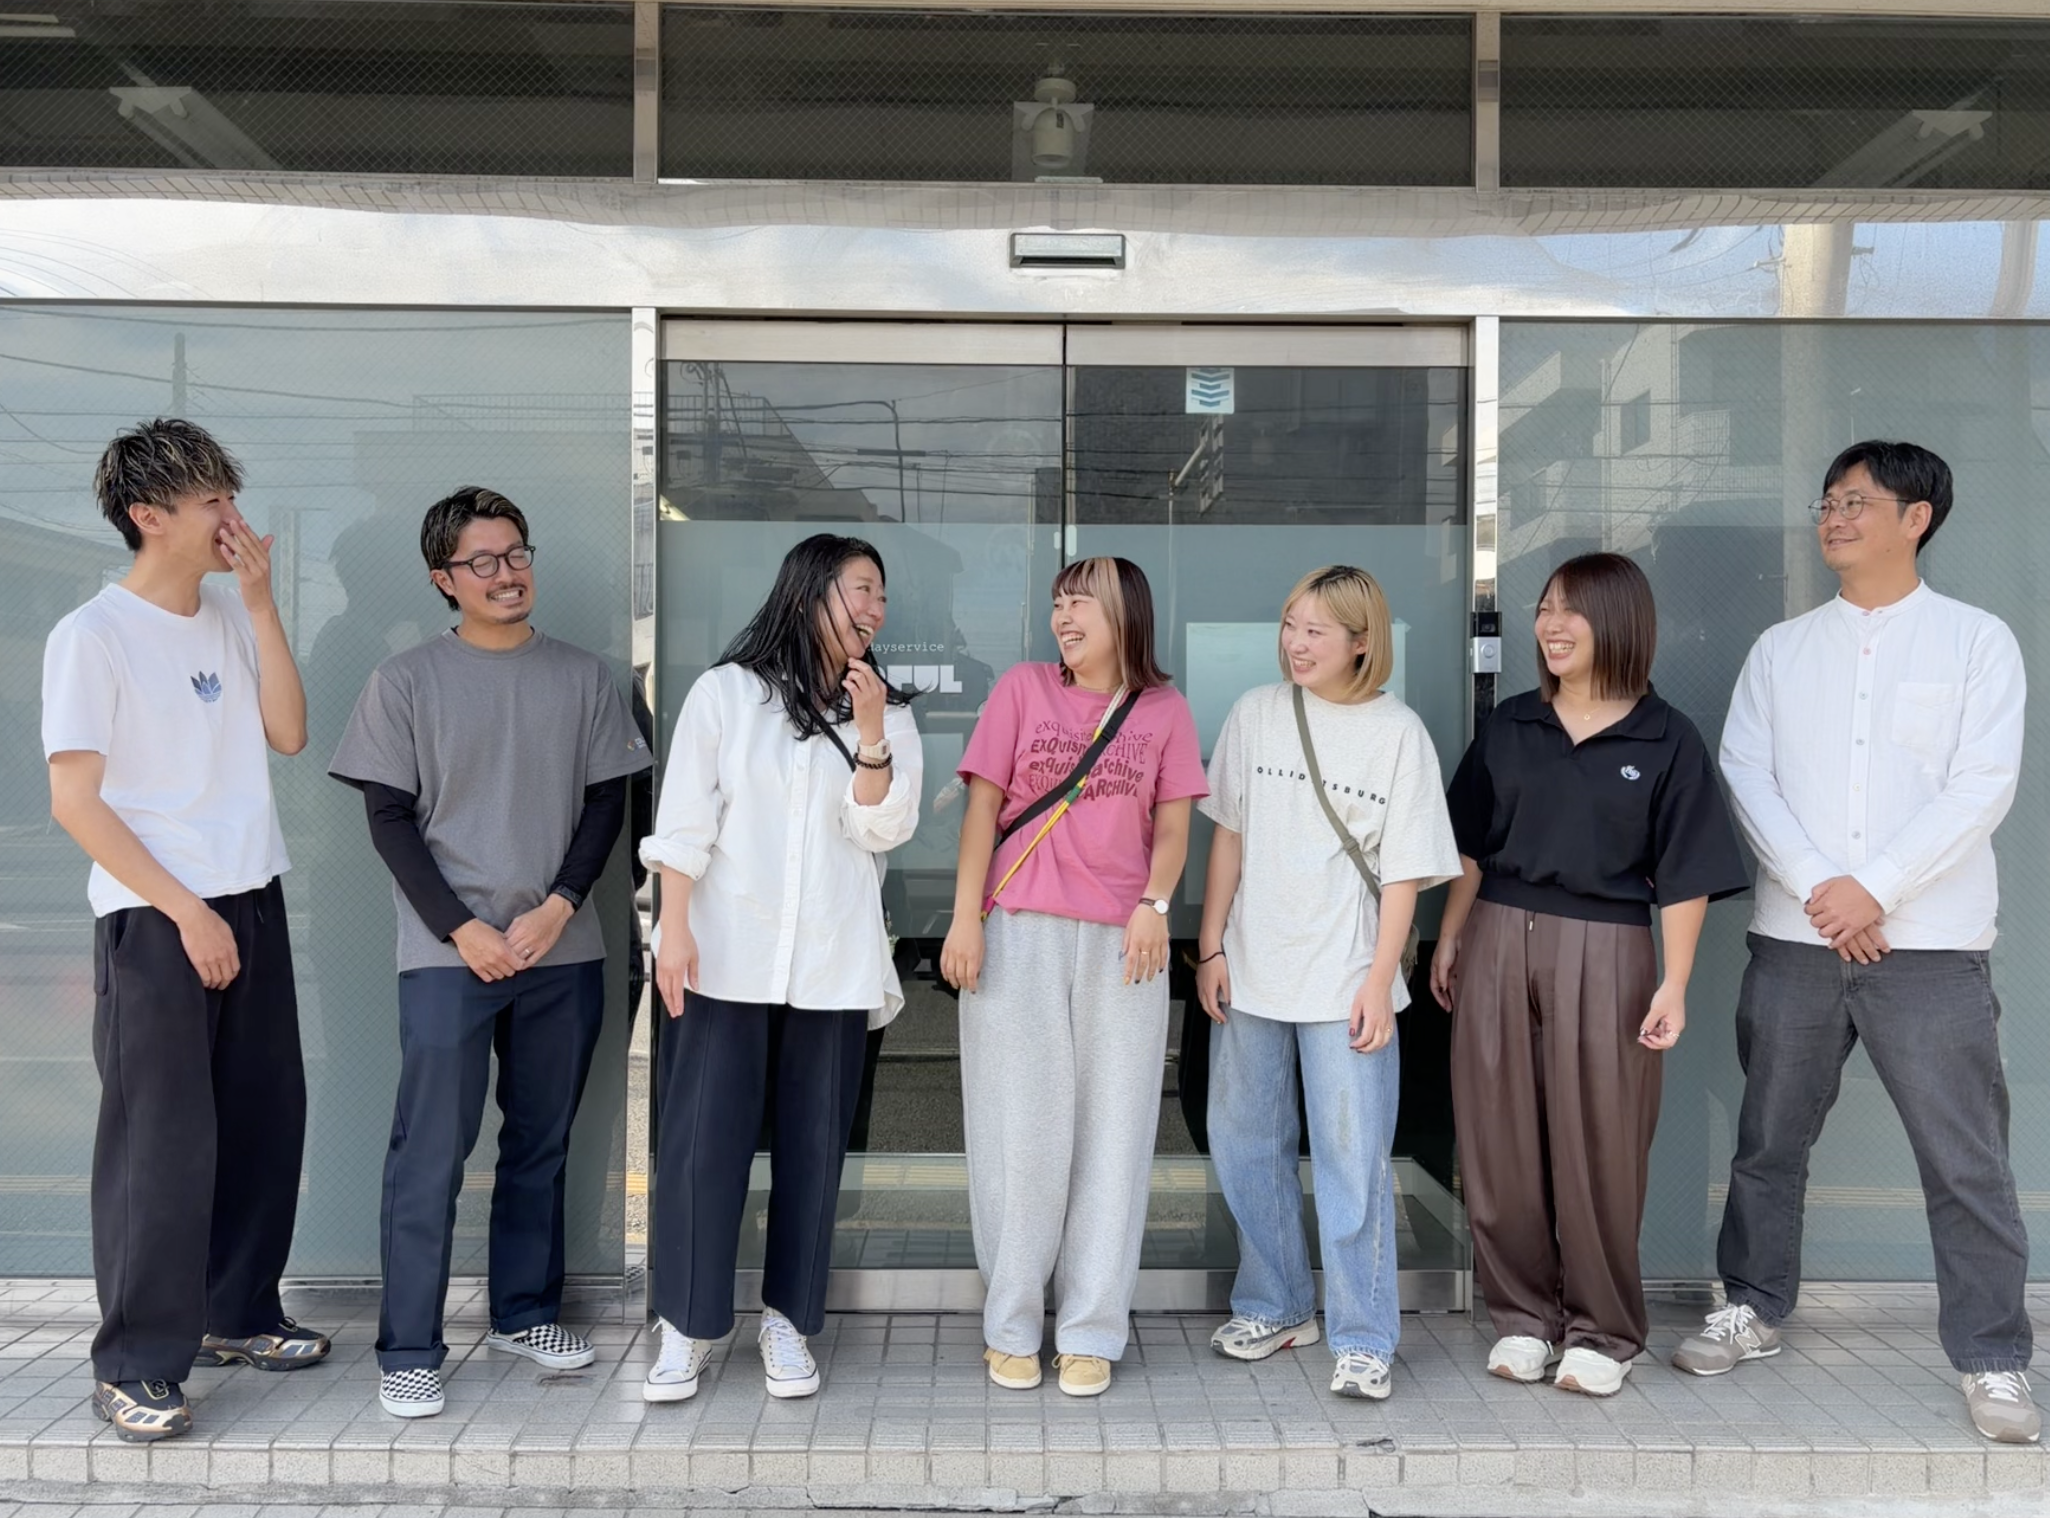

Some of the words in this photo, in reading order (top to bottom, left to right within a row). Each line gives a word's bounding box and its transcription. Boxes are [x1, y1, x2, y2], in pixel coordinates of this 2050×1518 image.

[1115, 731, 1153, 744] hive
[1031, 737, 1087, 755] EXQUISIT
[1102, 743, 1148, 764] CHIVE
[1091, 758, 1144, 783] archive
